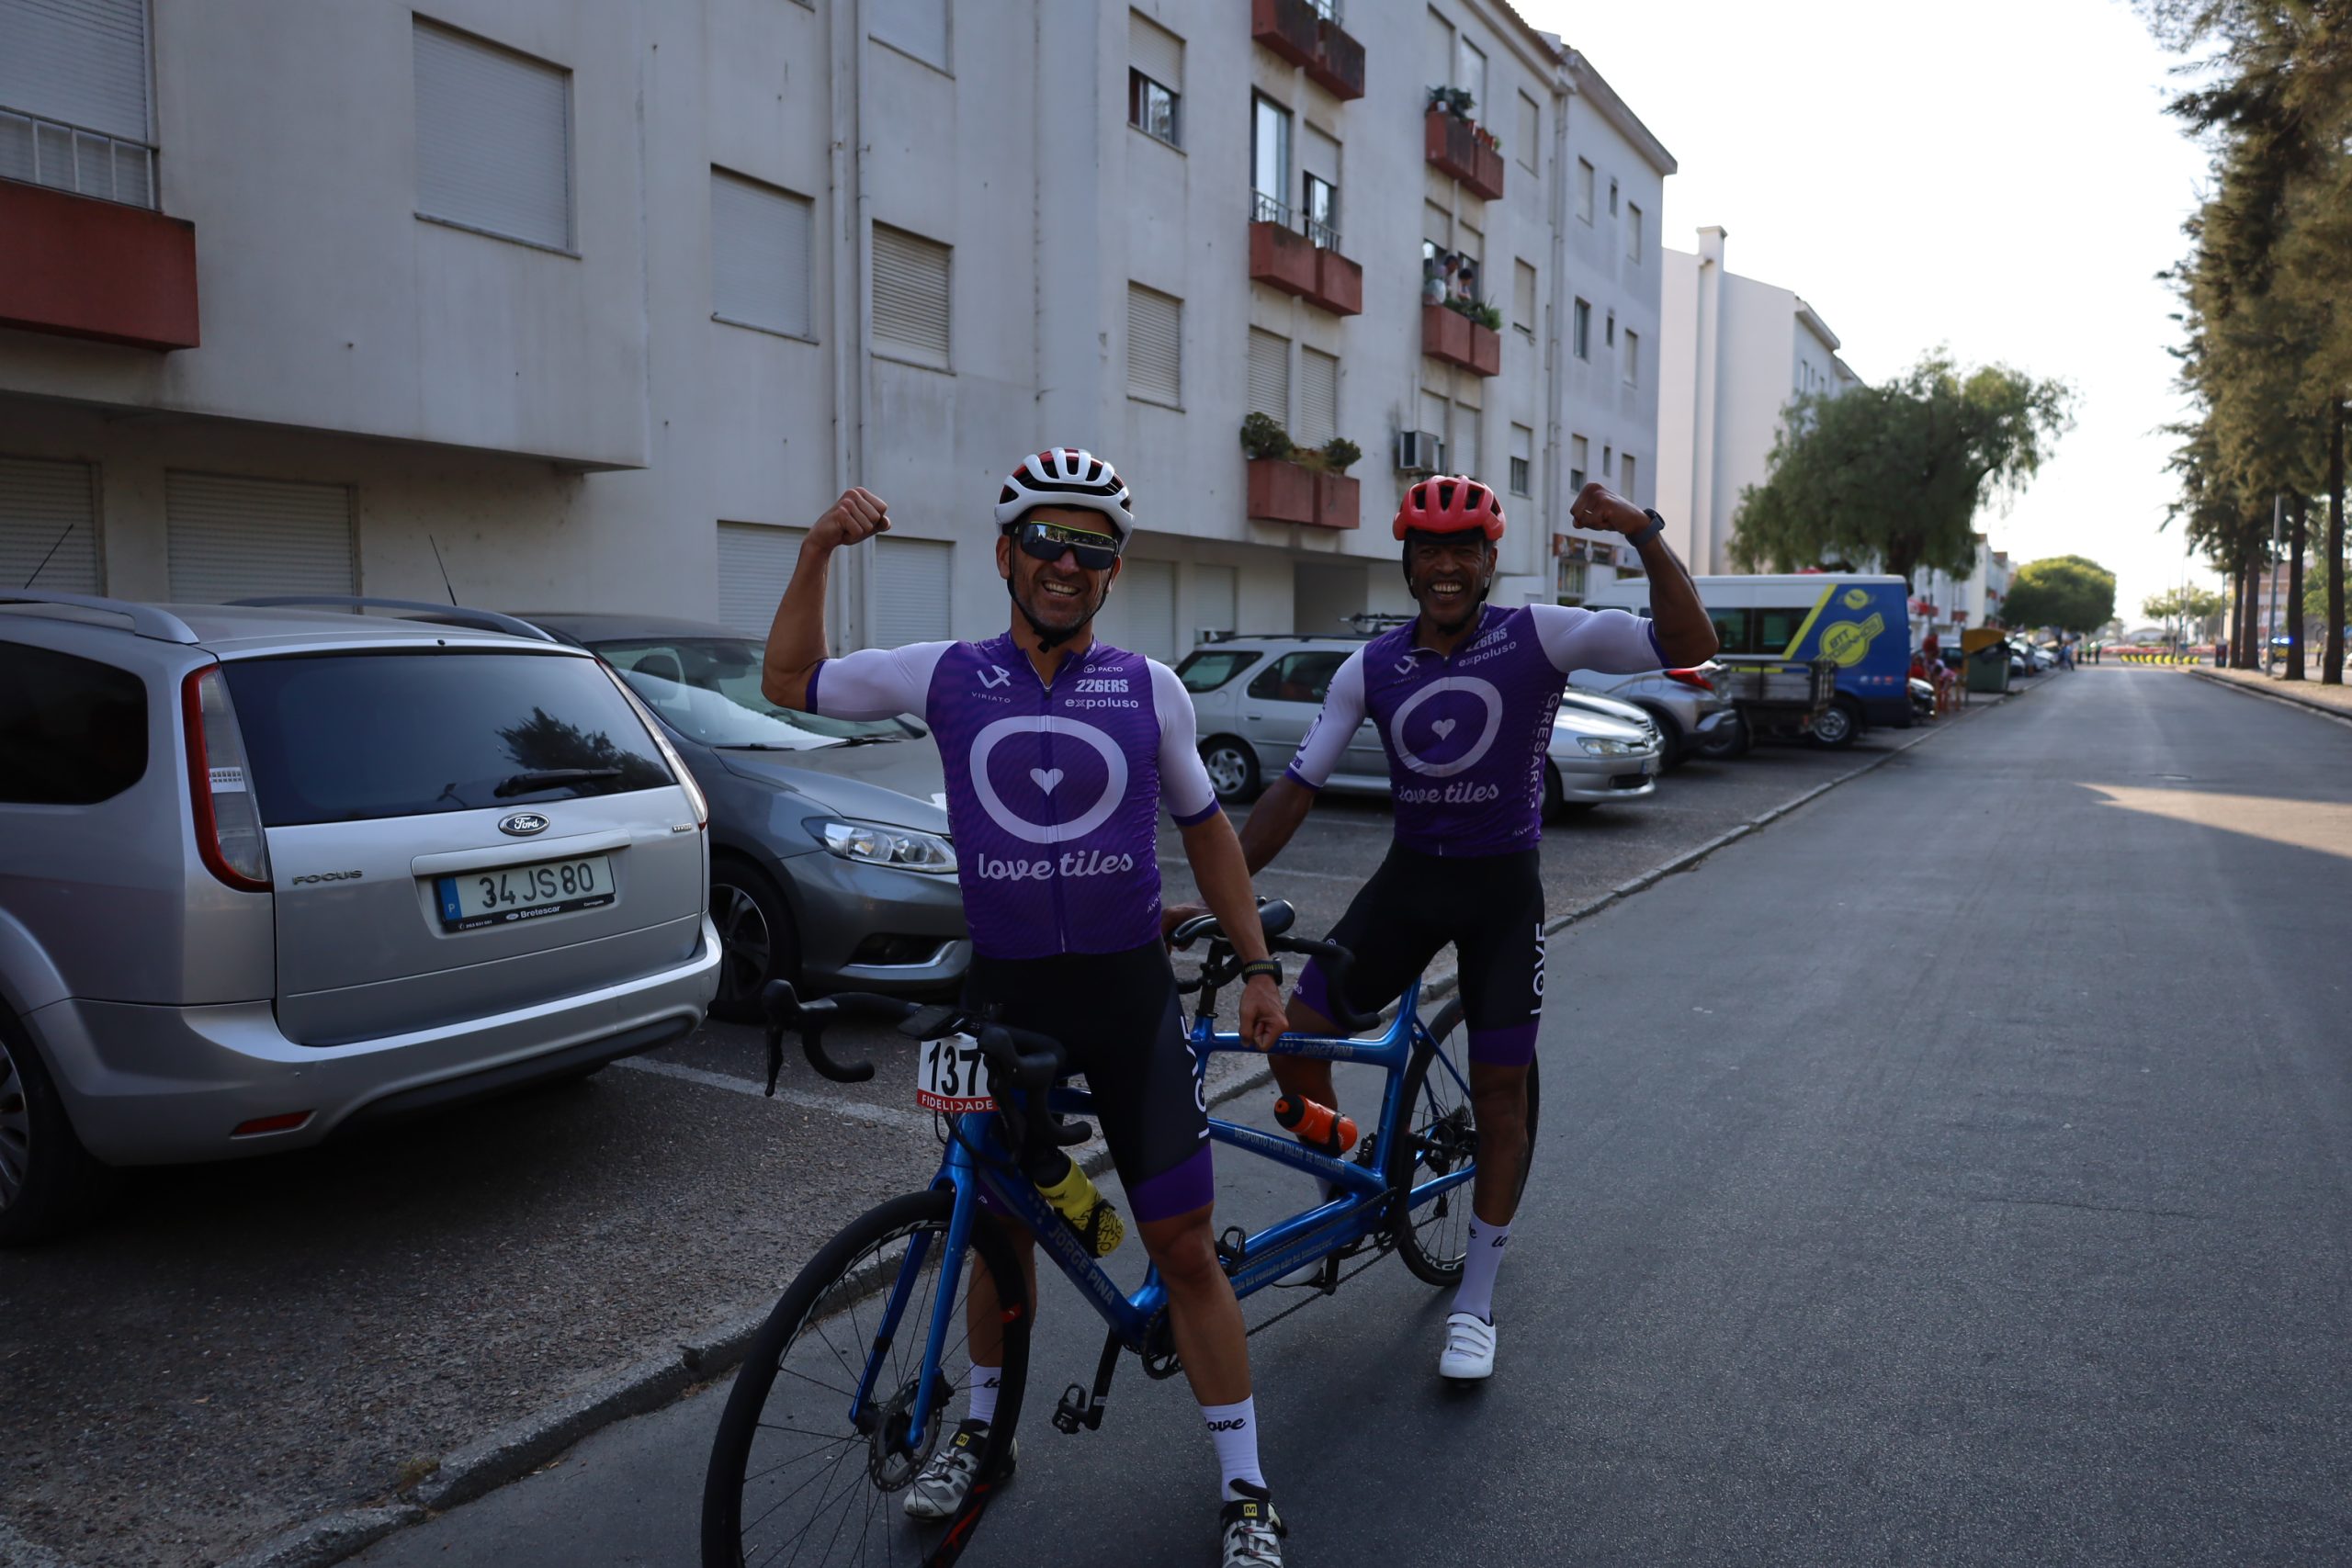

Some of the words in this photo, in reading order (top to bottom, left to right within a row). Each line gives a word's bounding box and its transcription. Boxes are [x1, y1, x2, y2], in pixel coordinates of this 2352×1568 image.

[1458, 641, 1517, 668] expoluso
[1074, 679, 1129, 693] 226ERS
[971, 691, 1012, 704] VIRIATO
[1065, 697, 1139, 710] expoluso
[1529, 692, 1560, 795] GRESART
[1398, 784, 1442, 805] love
[1444, 781, 1499, 804] tiles
[514, 817, 539, 829] Ford
[978, 852, 1055, 881] love
[1059, 850, 1134, 877] tiles
[292, 869, 363, 886] FOCUS
[520, 905, 561, 919] Bretescar
[928, 1041, 982, 1097] 137
[922, 1094, 993, 1111] FIDELIDADE
[1047, 1227, 1091, 1274] JORGE
[1086, 1268, 1115, 1305] PINA
